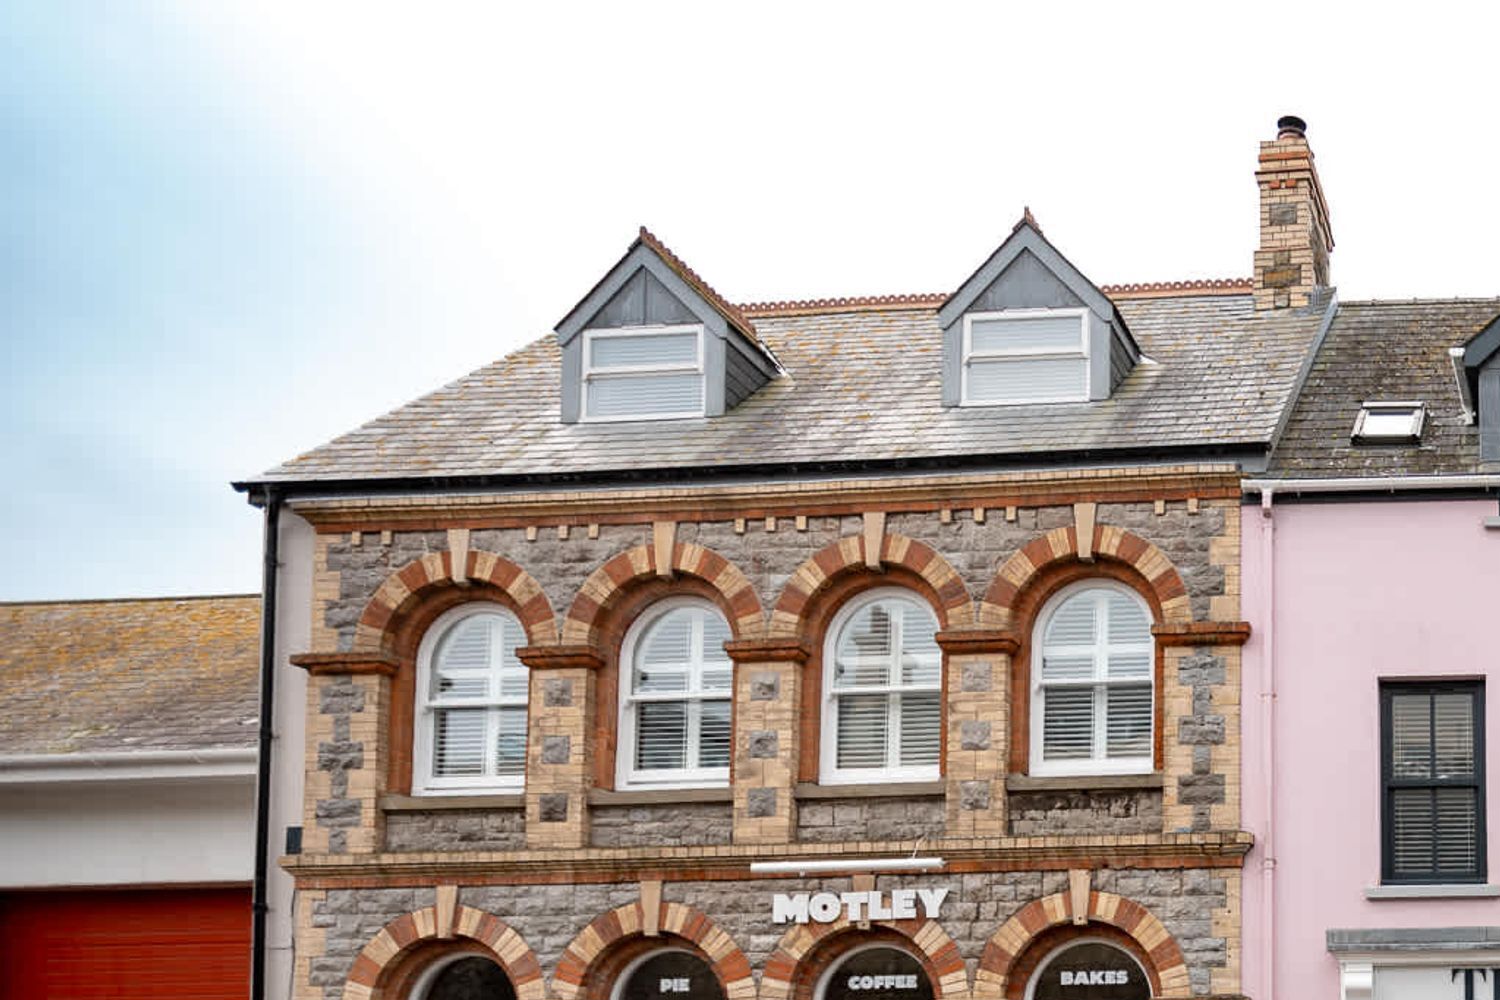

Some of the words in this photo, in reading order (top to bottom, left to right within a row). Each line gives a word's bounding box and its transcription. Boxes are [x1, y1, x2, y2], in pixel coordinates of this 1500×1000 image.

[772, 887, 950, 924] MOTLEY
[660, 978, 690, 993] PIE
[848, 974, 917, 990] COFFEE
[1060, 970, 1128, 986] BAKES
